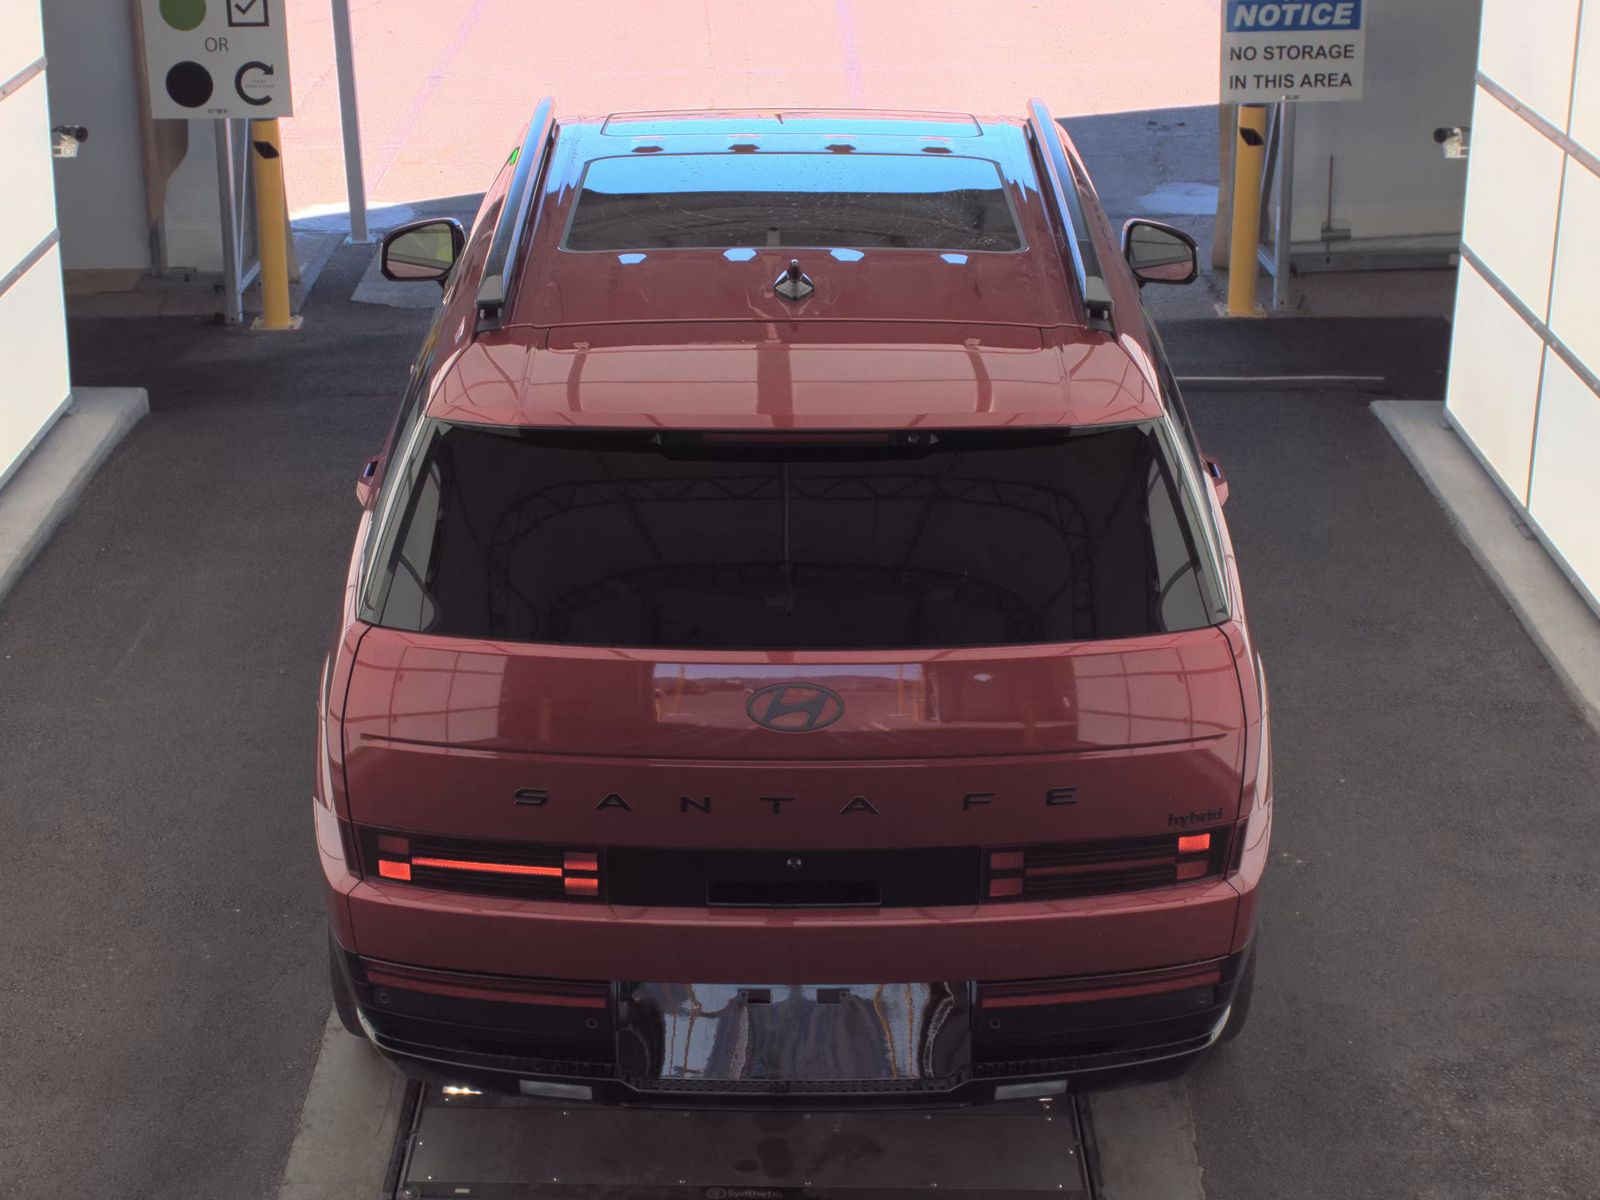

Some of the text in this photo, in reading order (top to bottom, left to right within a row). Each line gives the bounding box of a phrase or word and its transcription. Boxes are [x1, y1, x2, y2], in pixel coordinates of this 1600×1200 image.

[1233, 2, 1354, 27] NOTICE
[204, 37, 229, 52] OR
[1230, 44, 1354, 61] NO STORAGE
[1229, 72, 1352, 89] IN THIS AREA
[513, 787, 1077, 816] SANTA FE
[1168, 807, 1222, 827] hybrid
